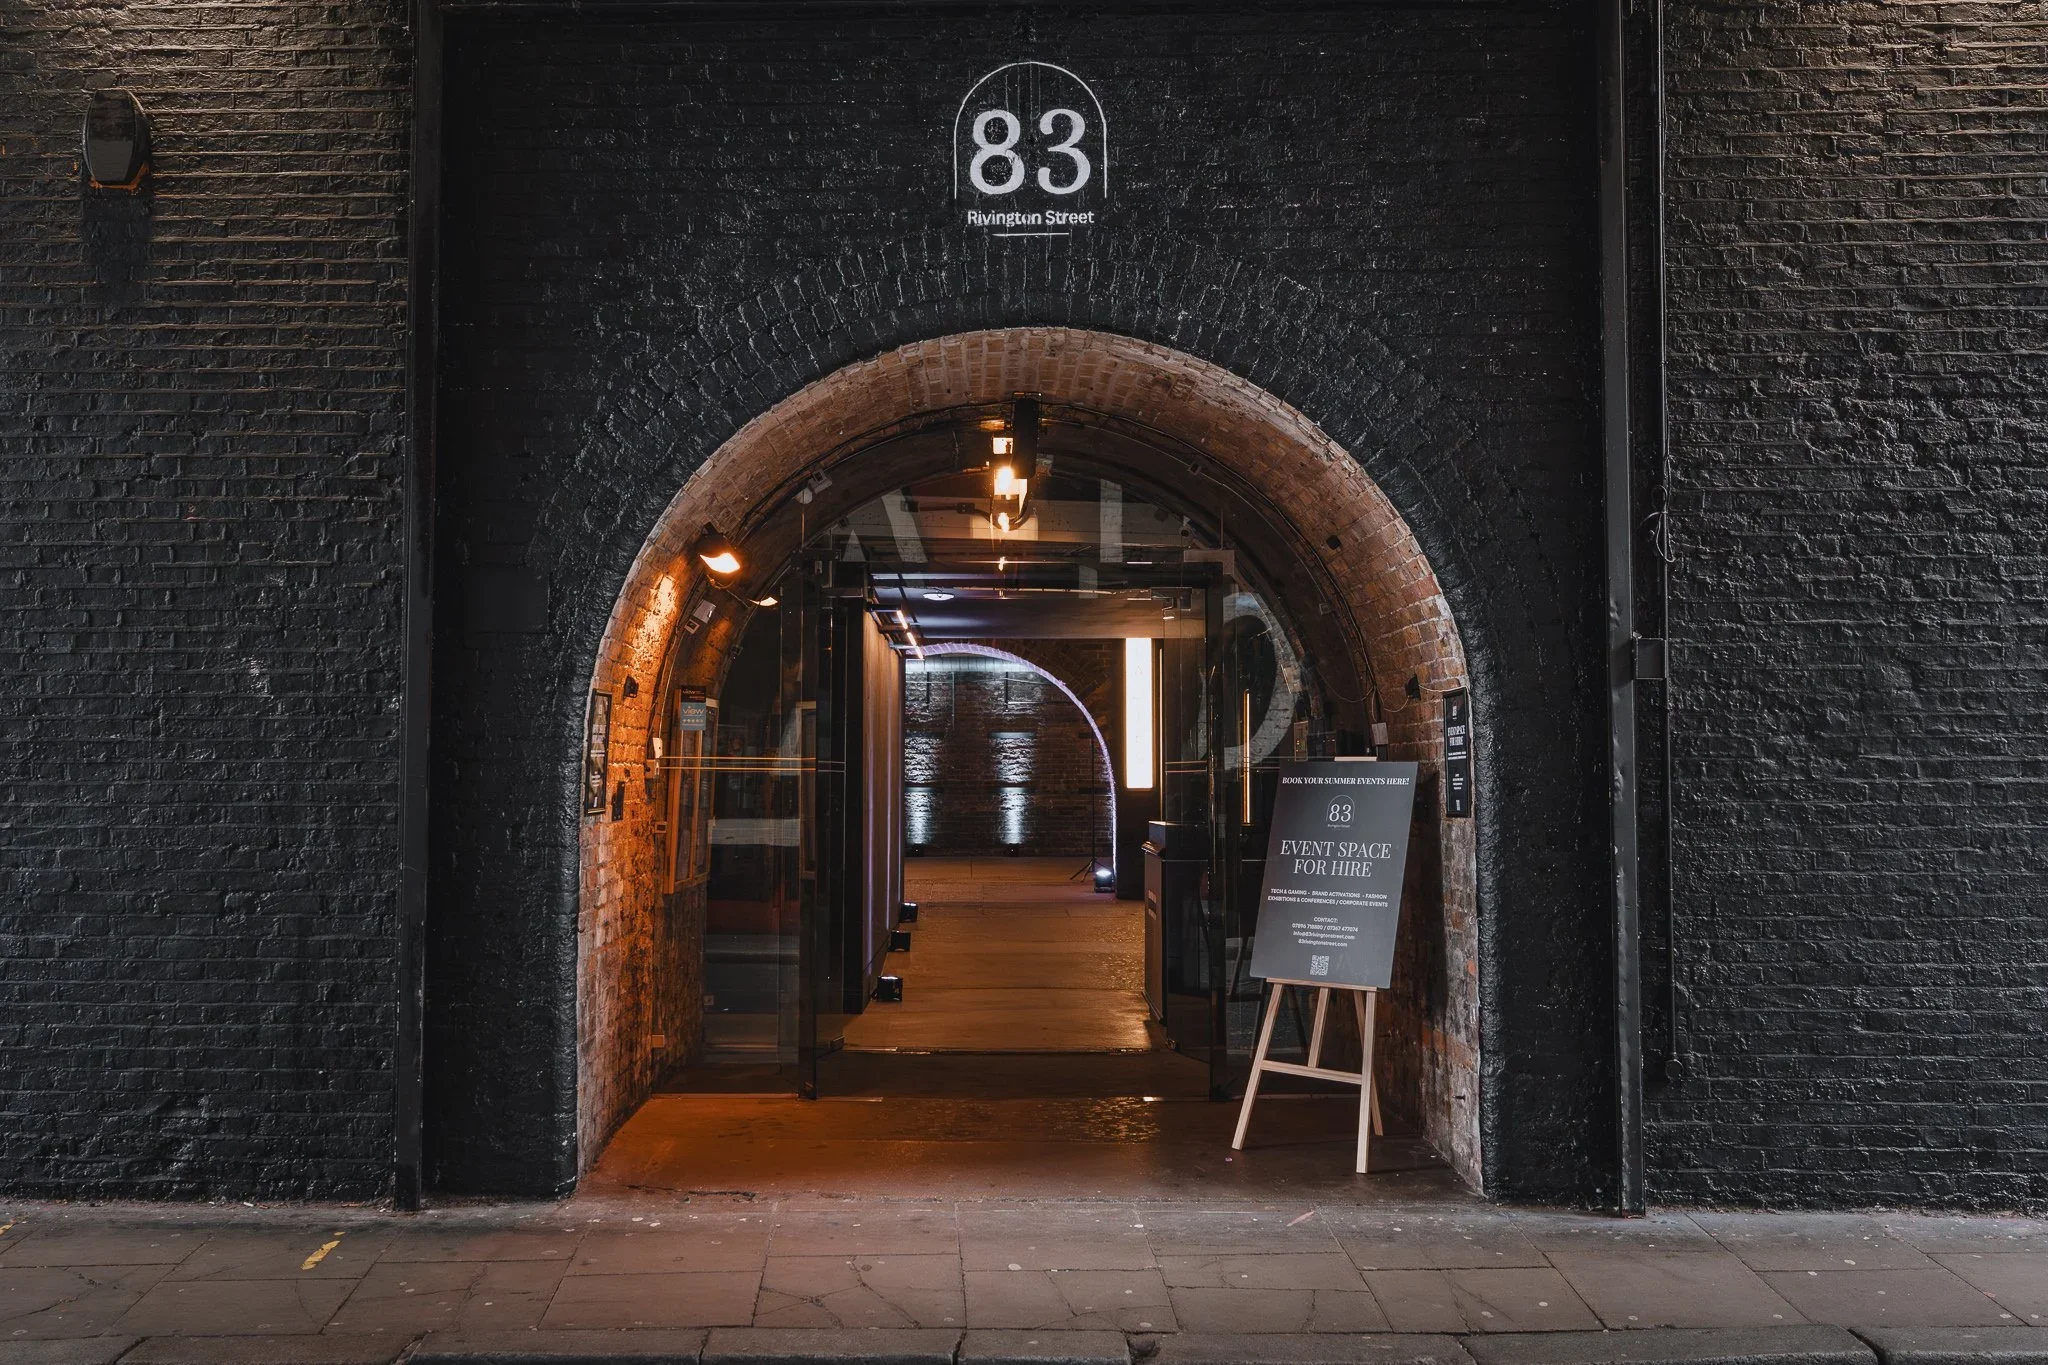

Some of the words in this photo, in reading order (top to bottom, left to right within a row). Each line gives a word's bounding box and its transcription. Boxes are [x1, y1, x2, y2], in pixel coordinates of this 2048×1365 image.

[970, 108, 1091, 195] 83
[967, 210, 1042, 227] Rivington
[1045, 210, 1095, 225] Street
[1324, 777, 1356, 785] SUMMER
[1357, 777, 1386, 785] EVENTS
[1386, 777, 1410, 785] HERE!
[1328, 803, 1352, 822] 83
[1280, 839, 1336, 858] EVENT
[1337, 841, 1392, 859] SPACE
[1293, 859, 1326, 875] FOR
[1331, 860, 1372, 878] HIRE
[1339, 899, 1369, 907] CORPORATE
